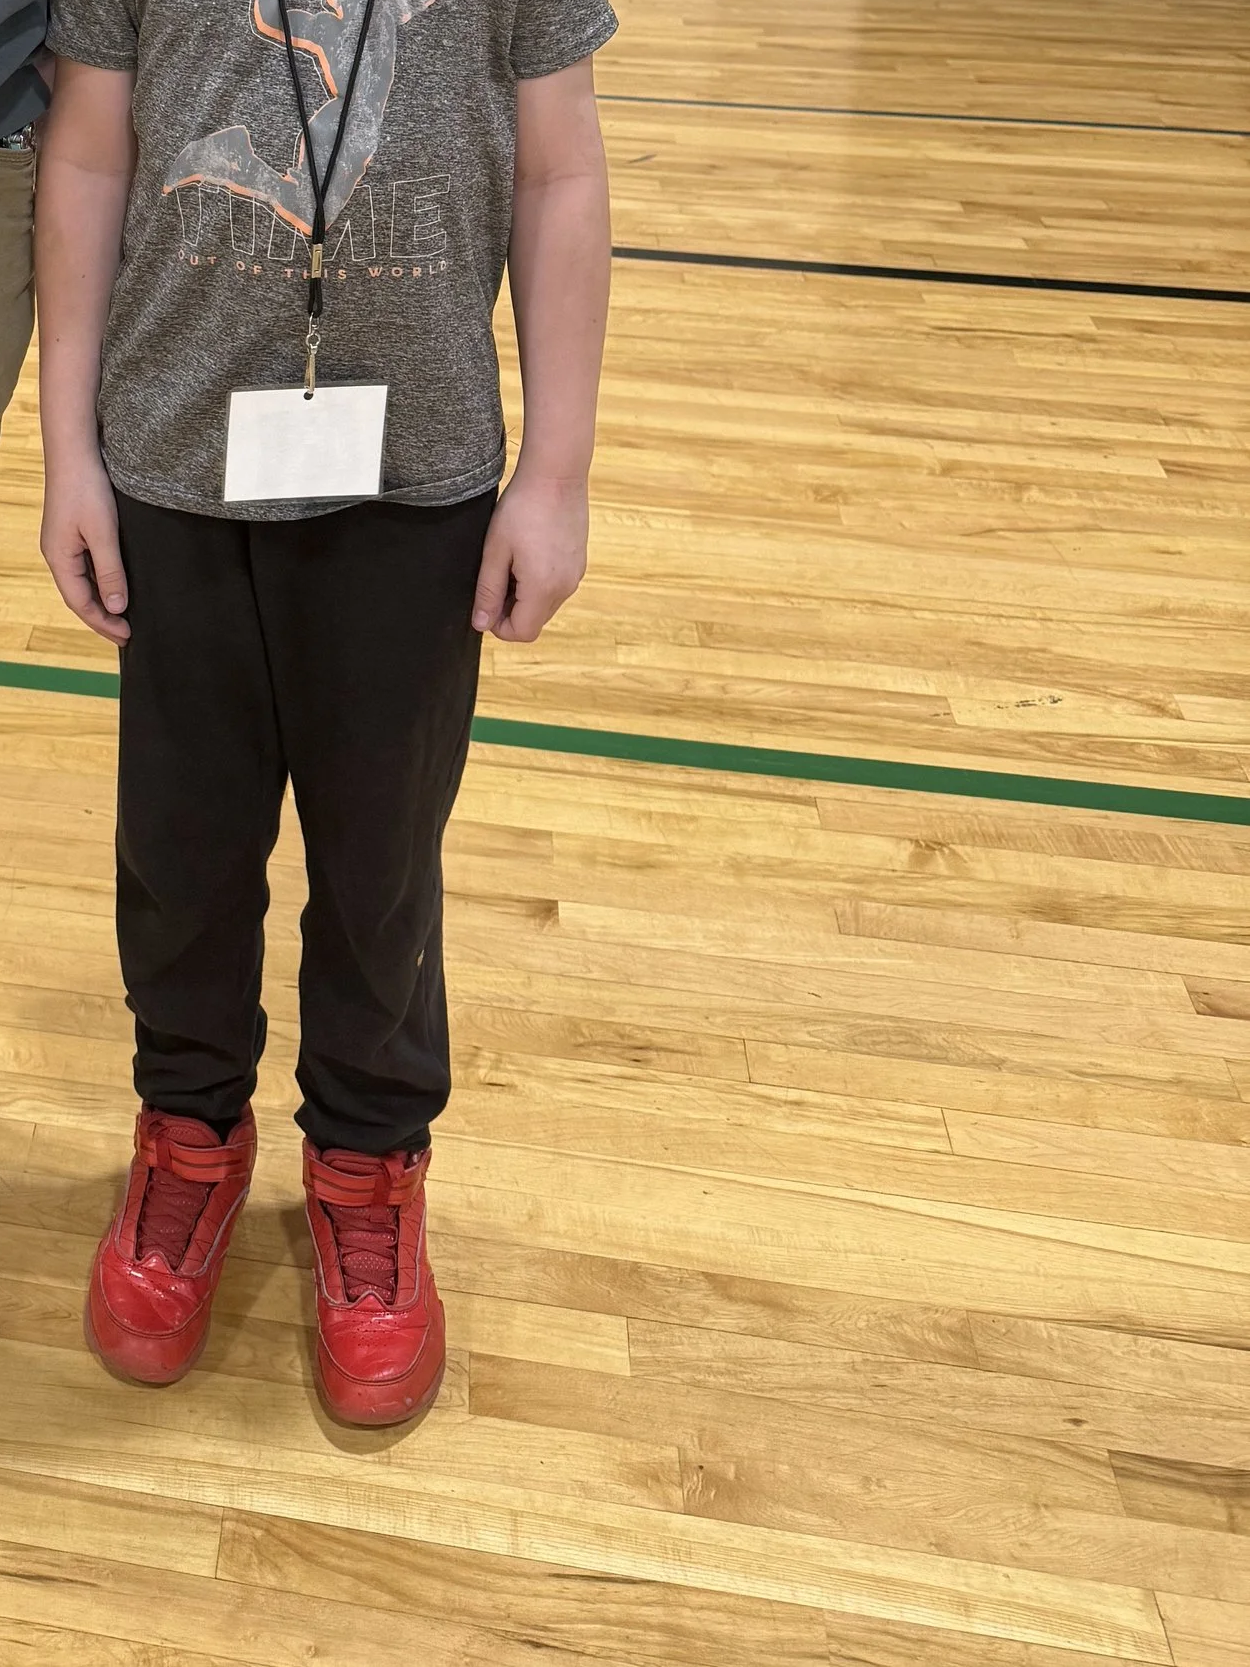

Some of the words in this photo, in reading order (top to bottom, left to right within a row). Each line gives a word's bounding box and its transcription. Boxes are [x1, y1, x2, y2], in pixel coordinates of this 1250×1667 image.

[175, 174, 451, 262] TIME
[177, 249, 217, 266] OUT
[236, 260, 263, 275] OF
[284, 268, 348, 281] THIS
[368, 260, 448, 278] WORLD
